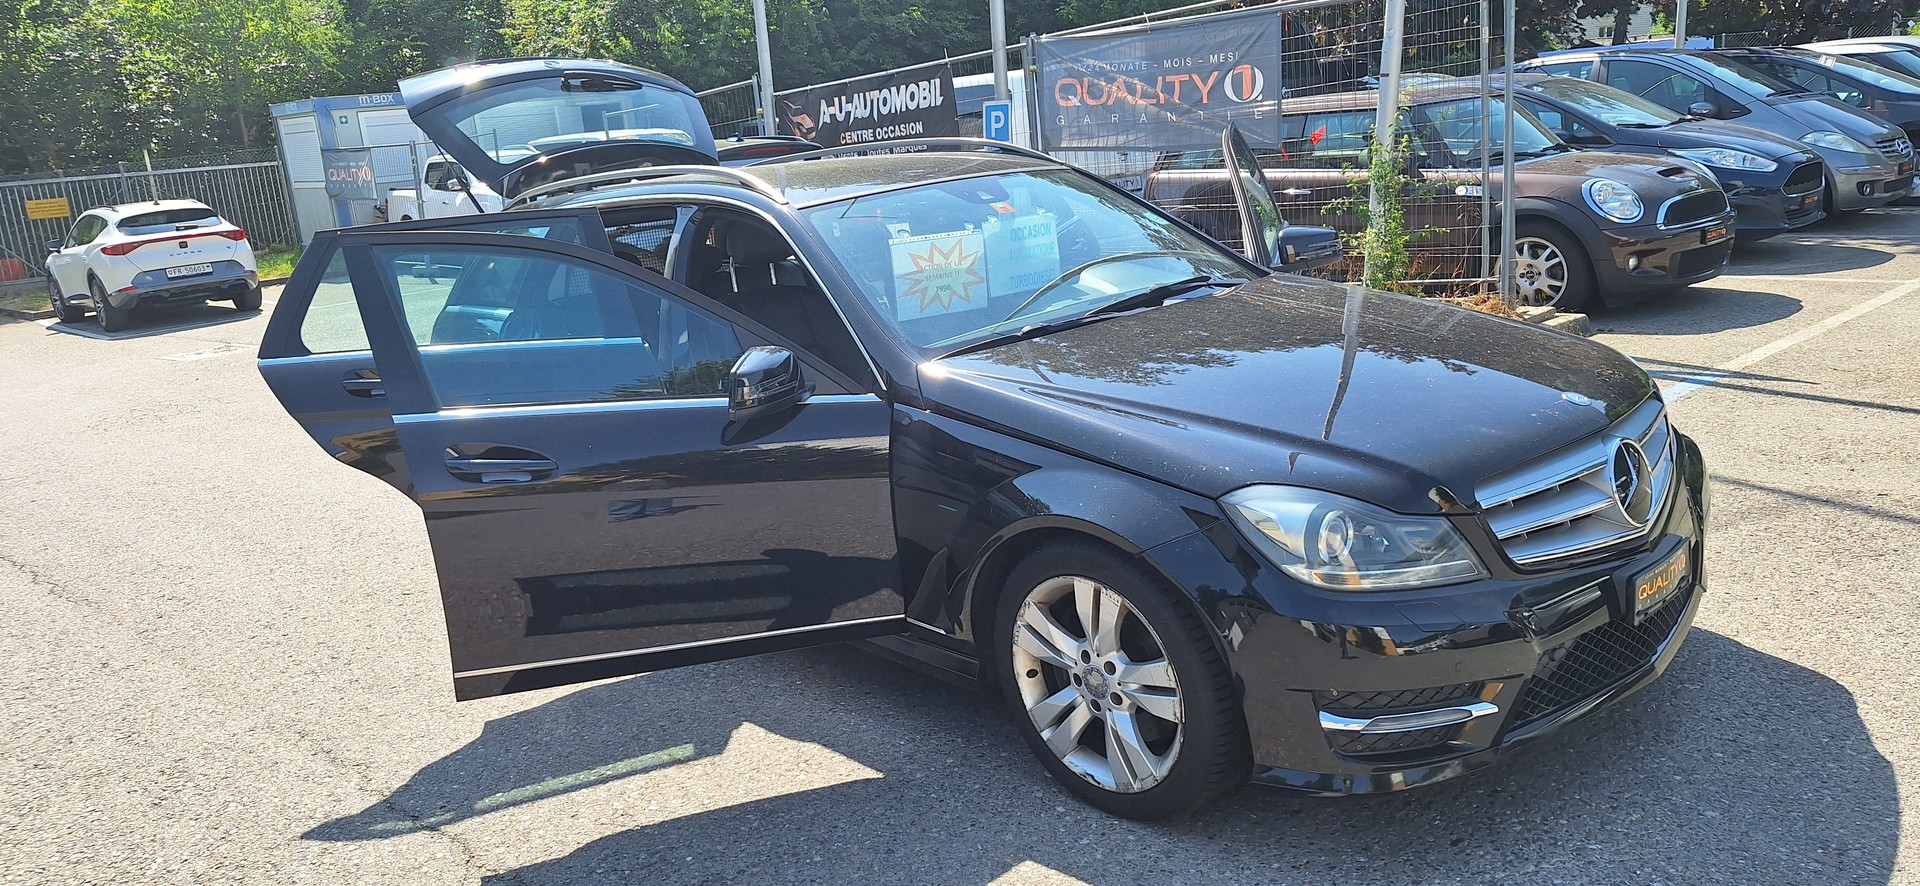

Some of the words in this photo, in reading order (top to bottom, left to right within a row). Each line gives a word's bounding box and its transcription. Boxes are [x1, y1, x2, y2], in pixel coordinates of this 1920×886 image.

[1103, 61, 1148, 72] MONATE
[1163, 55, 1193, 68] MOIS
[1208, 51, 1239, 64] MESI
[1054, 70, 1220, 108] QUALITY
[818, 78, 944, 131] A-U-AUTOMOBIL
[990, 110, 1005, 138] P
[1055, 109, 1264, 126] GARANTIE
[840, 128, 874, 145] CENTRE
[876, 121, 924, 140] OCCASION
[892, 144, 928, 155] Marques
[1010, 222, 1052, 242] OCCASION
[925, 271, 953, 282] SEMAINE
[1638, 562, 1679, 600] QUALITY
